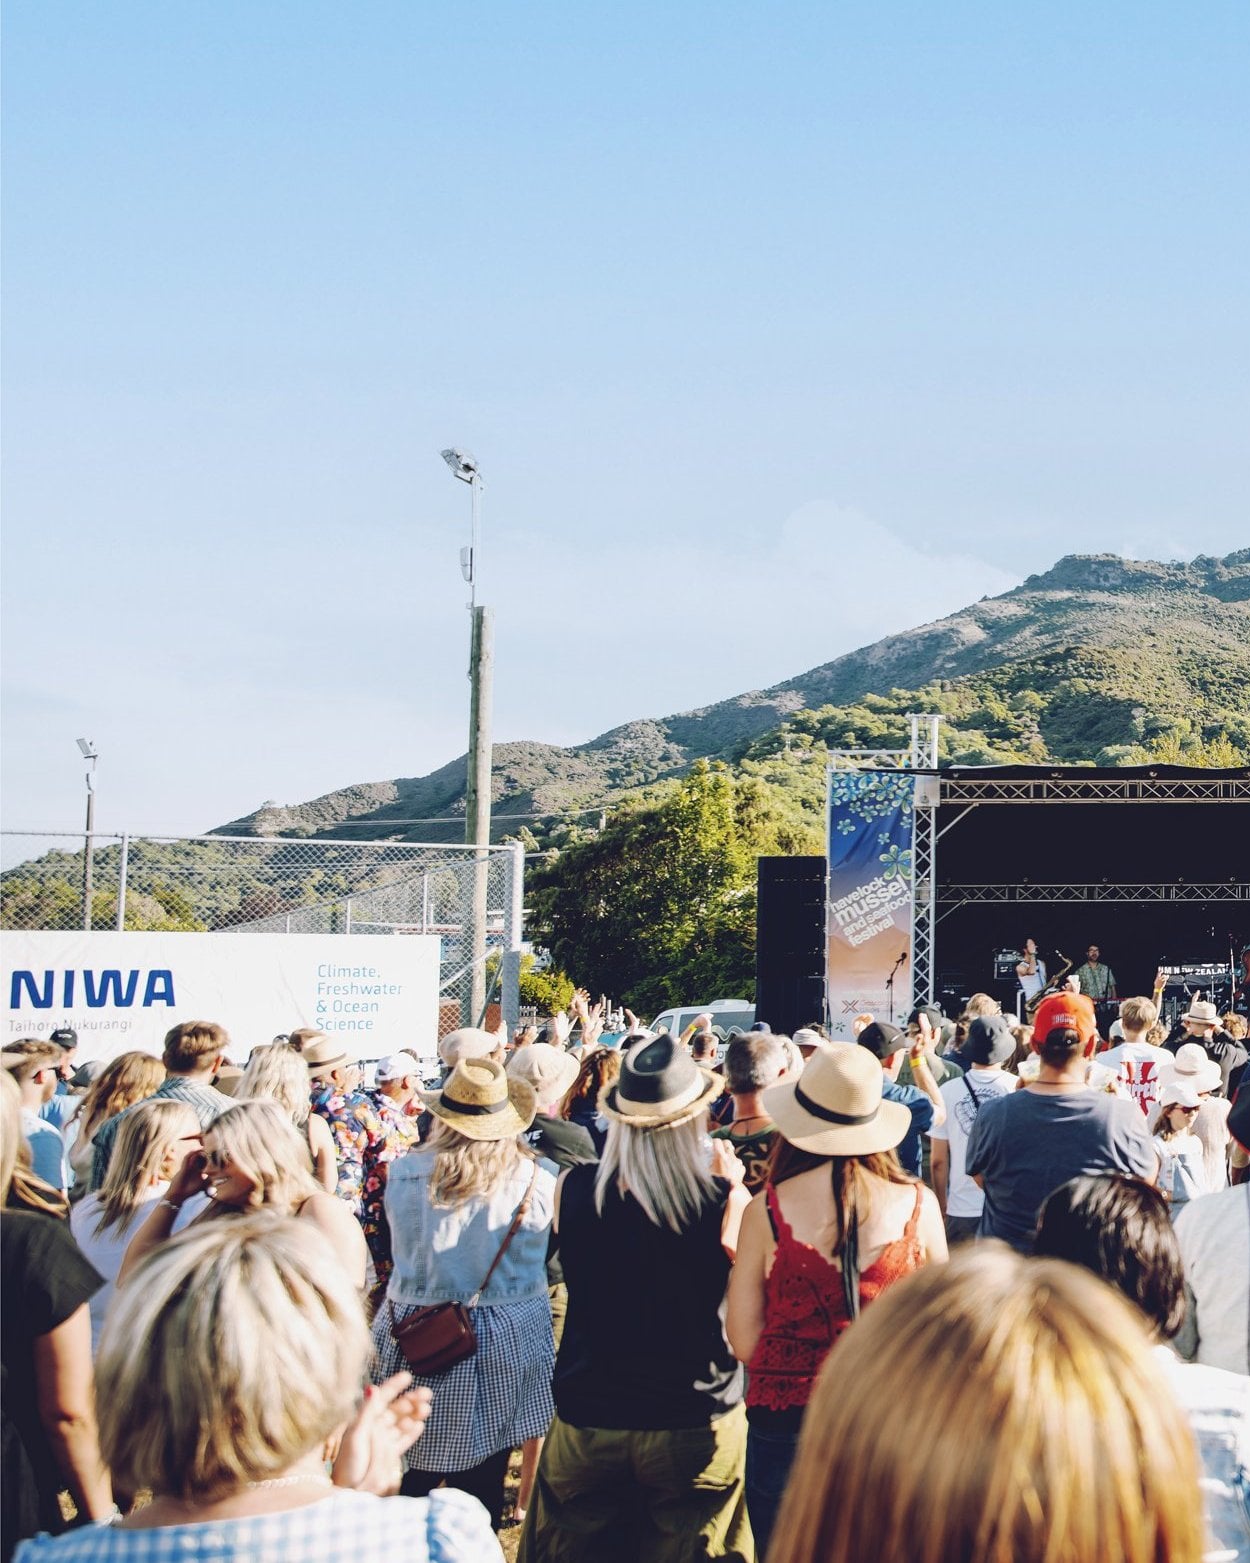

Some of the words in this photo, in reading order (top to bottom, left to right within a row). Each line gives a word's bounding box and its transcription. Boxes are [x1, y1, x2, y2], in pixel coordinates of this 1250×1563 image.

[829, 876, 887, 913] havelock
[834, 874, 908, 926] mussel
[843, 916, 868, 937] and
[866, 890, 912, 923] seafood
[848, 914, 895, 947] festival
[1195, 968, 1229, 976] ZEALAN
[10, 970, 176, 1009] NIWA
[317, 982, 407, 995] Freshwater
[316, 999, 328, 1013] &
[333, 999, 379, 1013] Ocean
[8, 1019, 58, 1032] Taihoro
[63, 1017, 133, 1033] Nukurangi
[315, 1017, 374, 1031] Science
